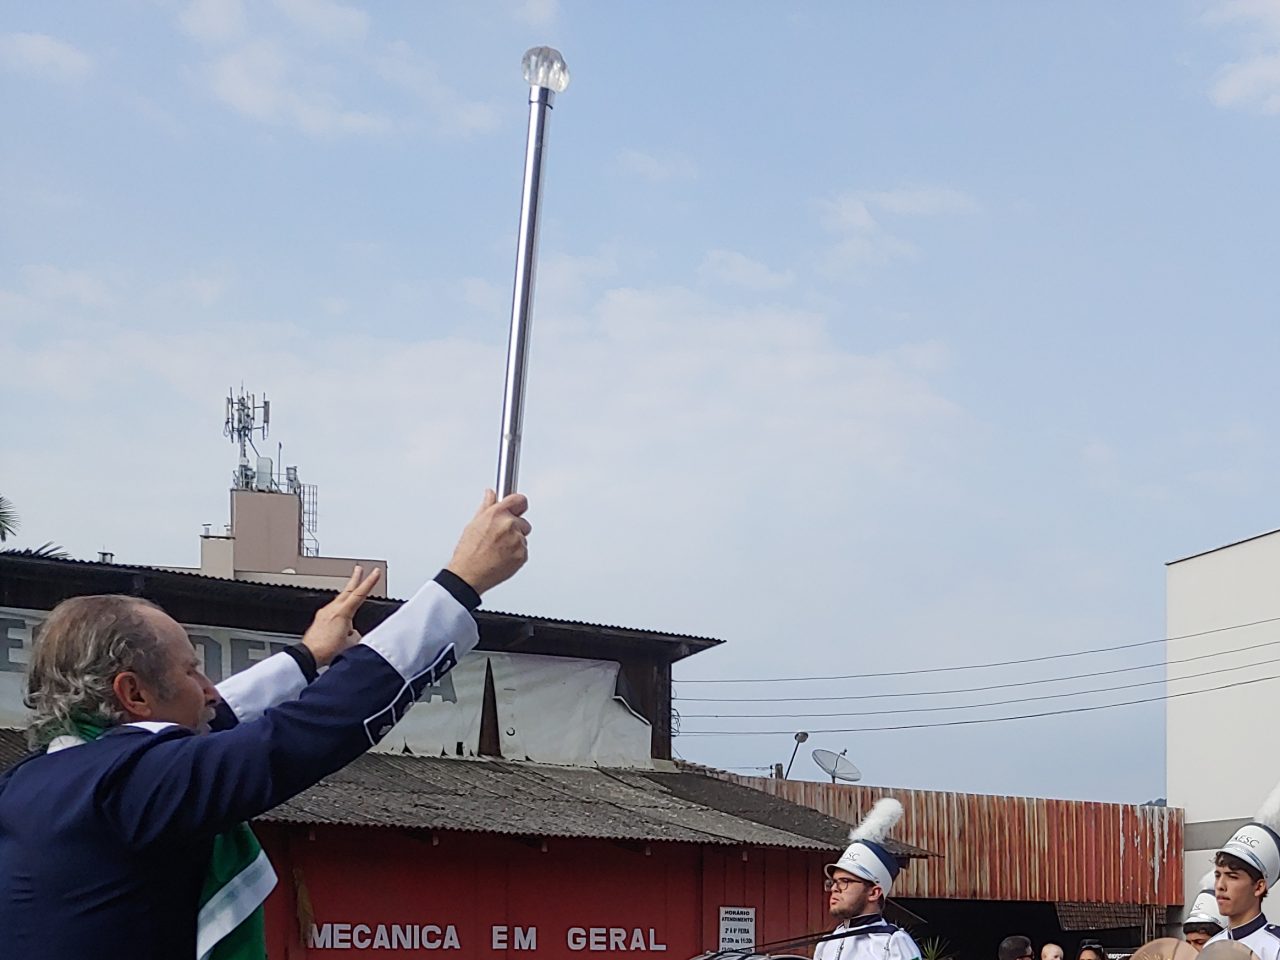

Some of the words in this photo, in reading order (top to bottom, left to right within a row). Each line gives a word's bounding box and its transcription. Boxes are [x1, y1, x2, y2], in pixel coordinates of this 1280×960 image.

[309, 923, 461, 950] MECANICA
[492, 925, 537, 951] EM
[566, 926, 667, 951] GERAL
